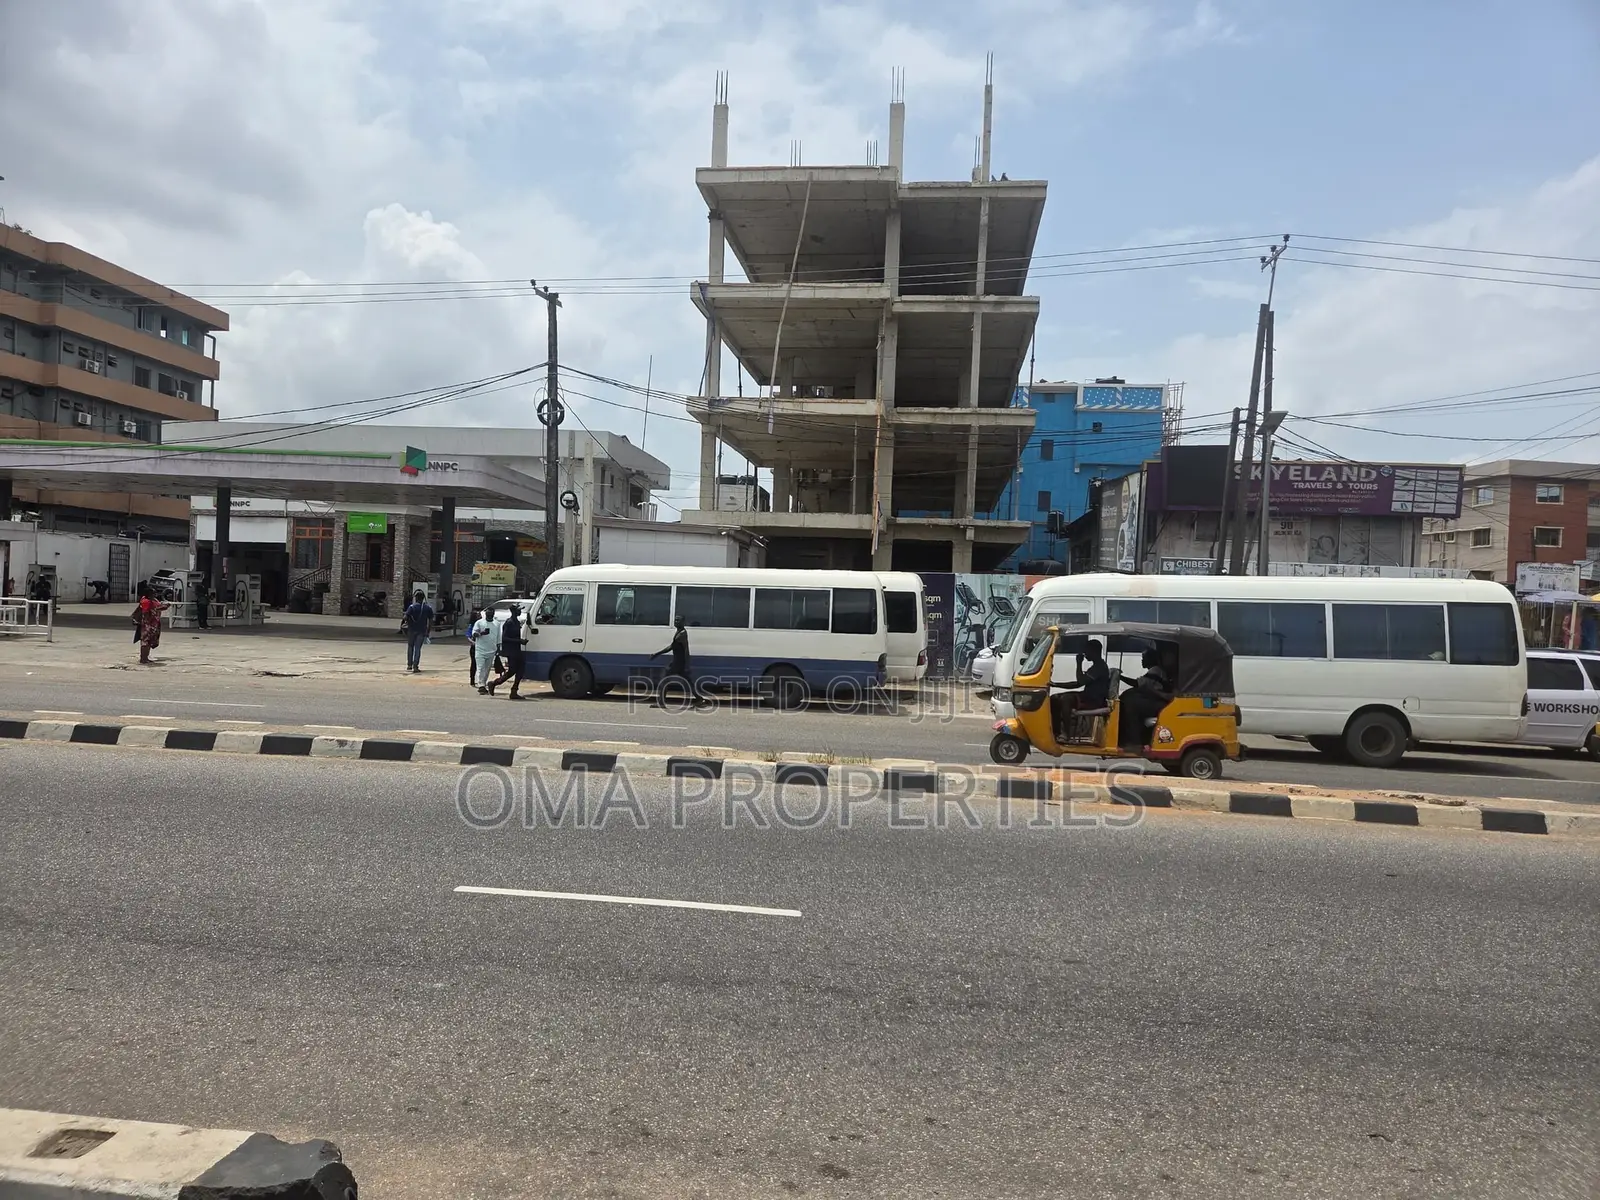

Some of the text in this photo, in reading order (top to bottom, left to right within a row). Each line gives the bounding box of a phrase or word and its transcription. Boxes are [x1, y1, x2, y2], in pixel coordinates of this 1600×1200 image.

[428, 462, 459, 471] NNPC
[1176, 560, 1214, 568] CHIBEST
[928, 612, 943, 620] qm
